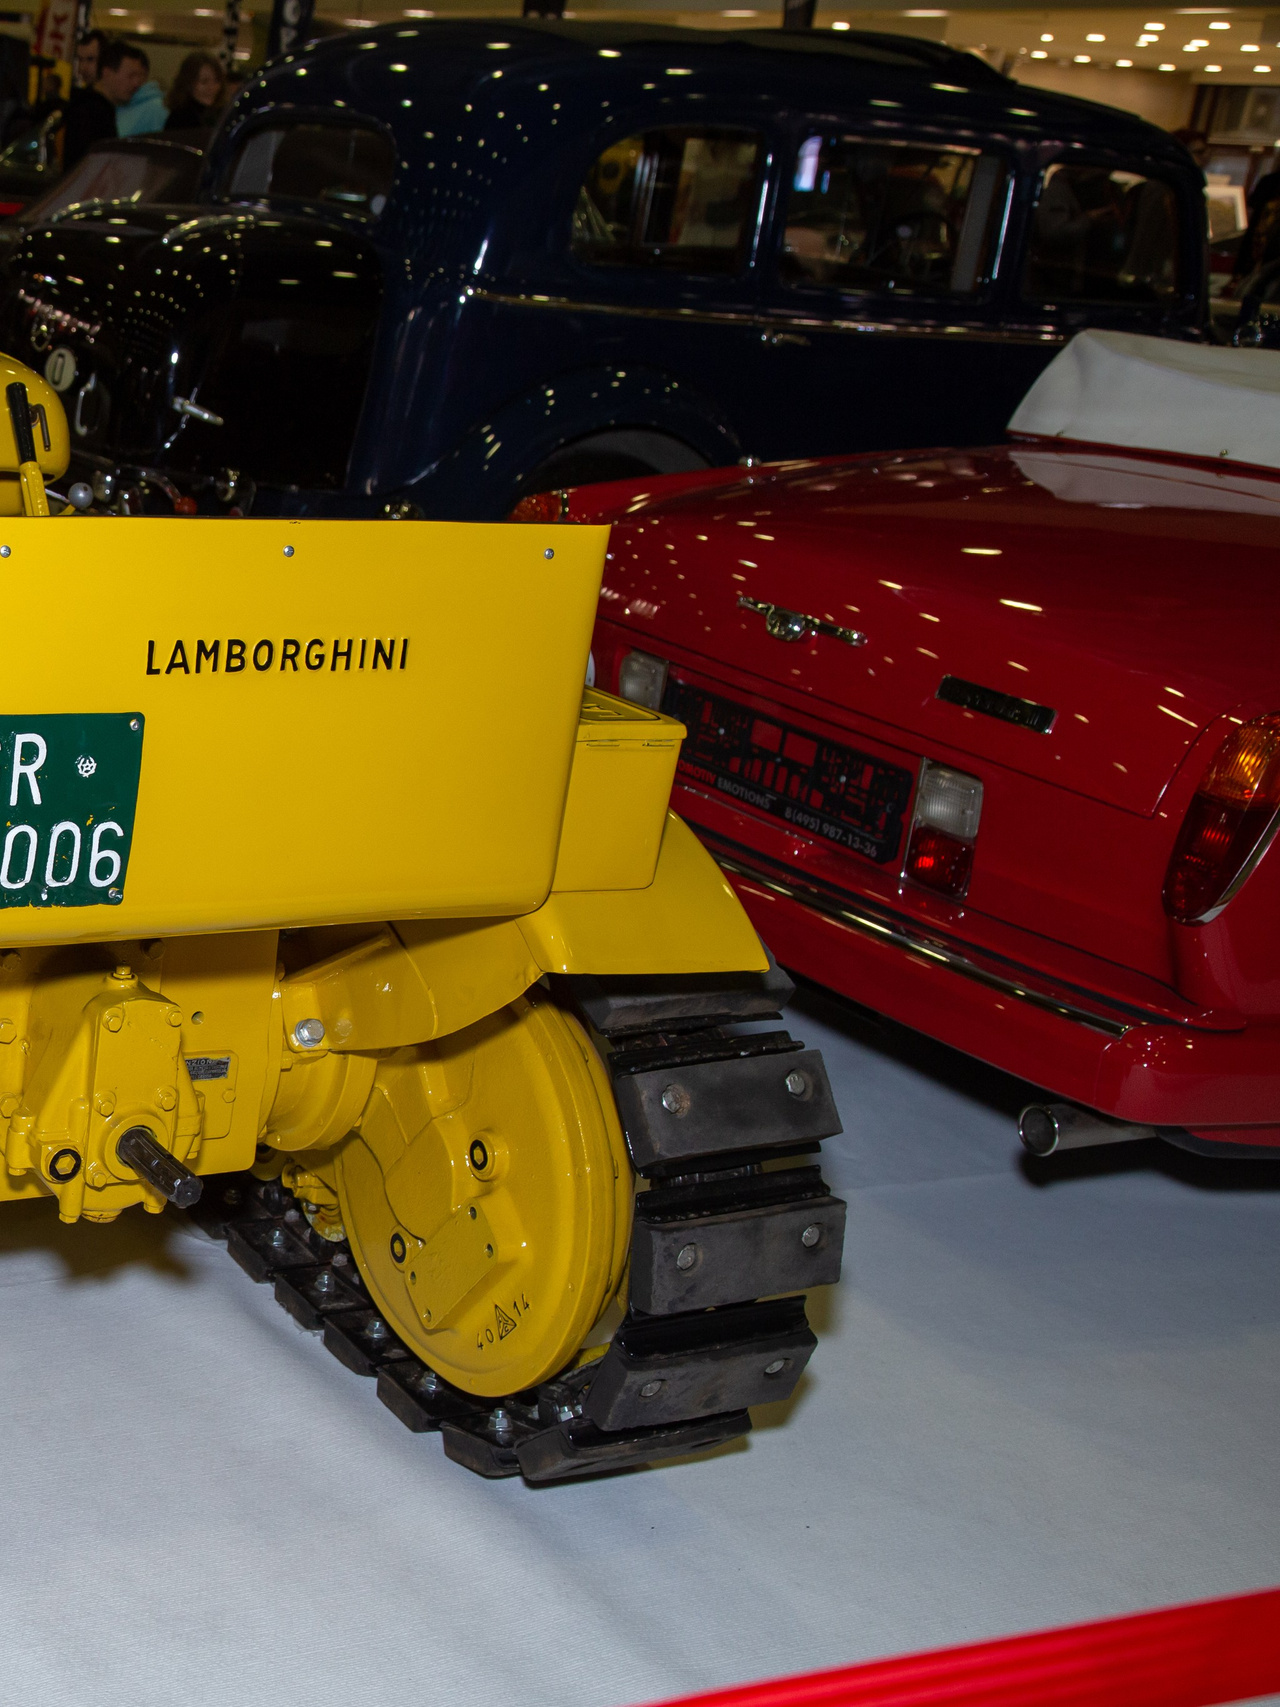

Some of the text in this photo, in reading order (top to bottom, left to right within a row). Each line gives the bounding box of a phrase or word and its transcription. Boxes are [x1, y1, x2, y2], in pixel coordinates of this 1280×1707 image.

[146, 638, 408, 675] LAMBORGHINI
[716, 776, 773, 810] EMOTIONS
[821, 822, 878, 858] 987-13-36
